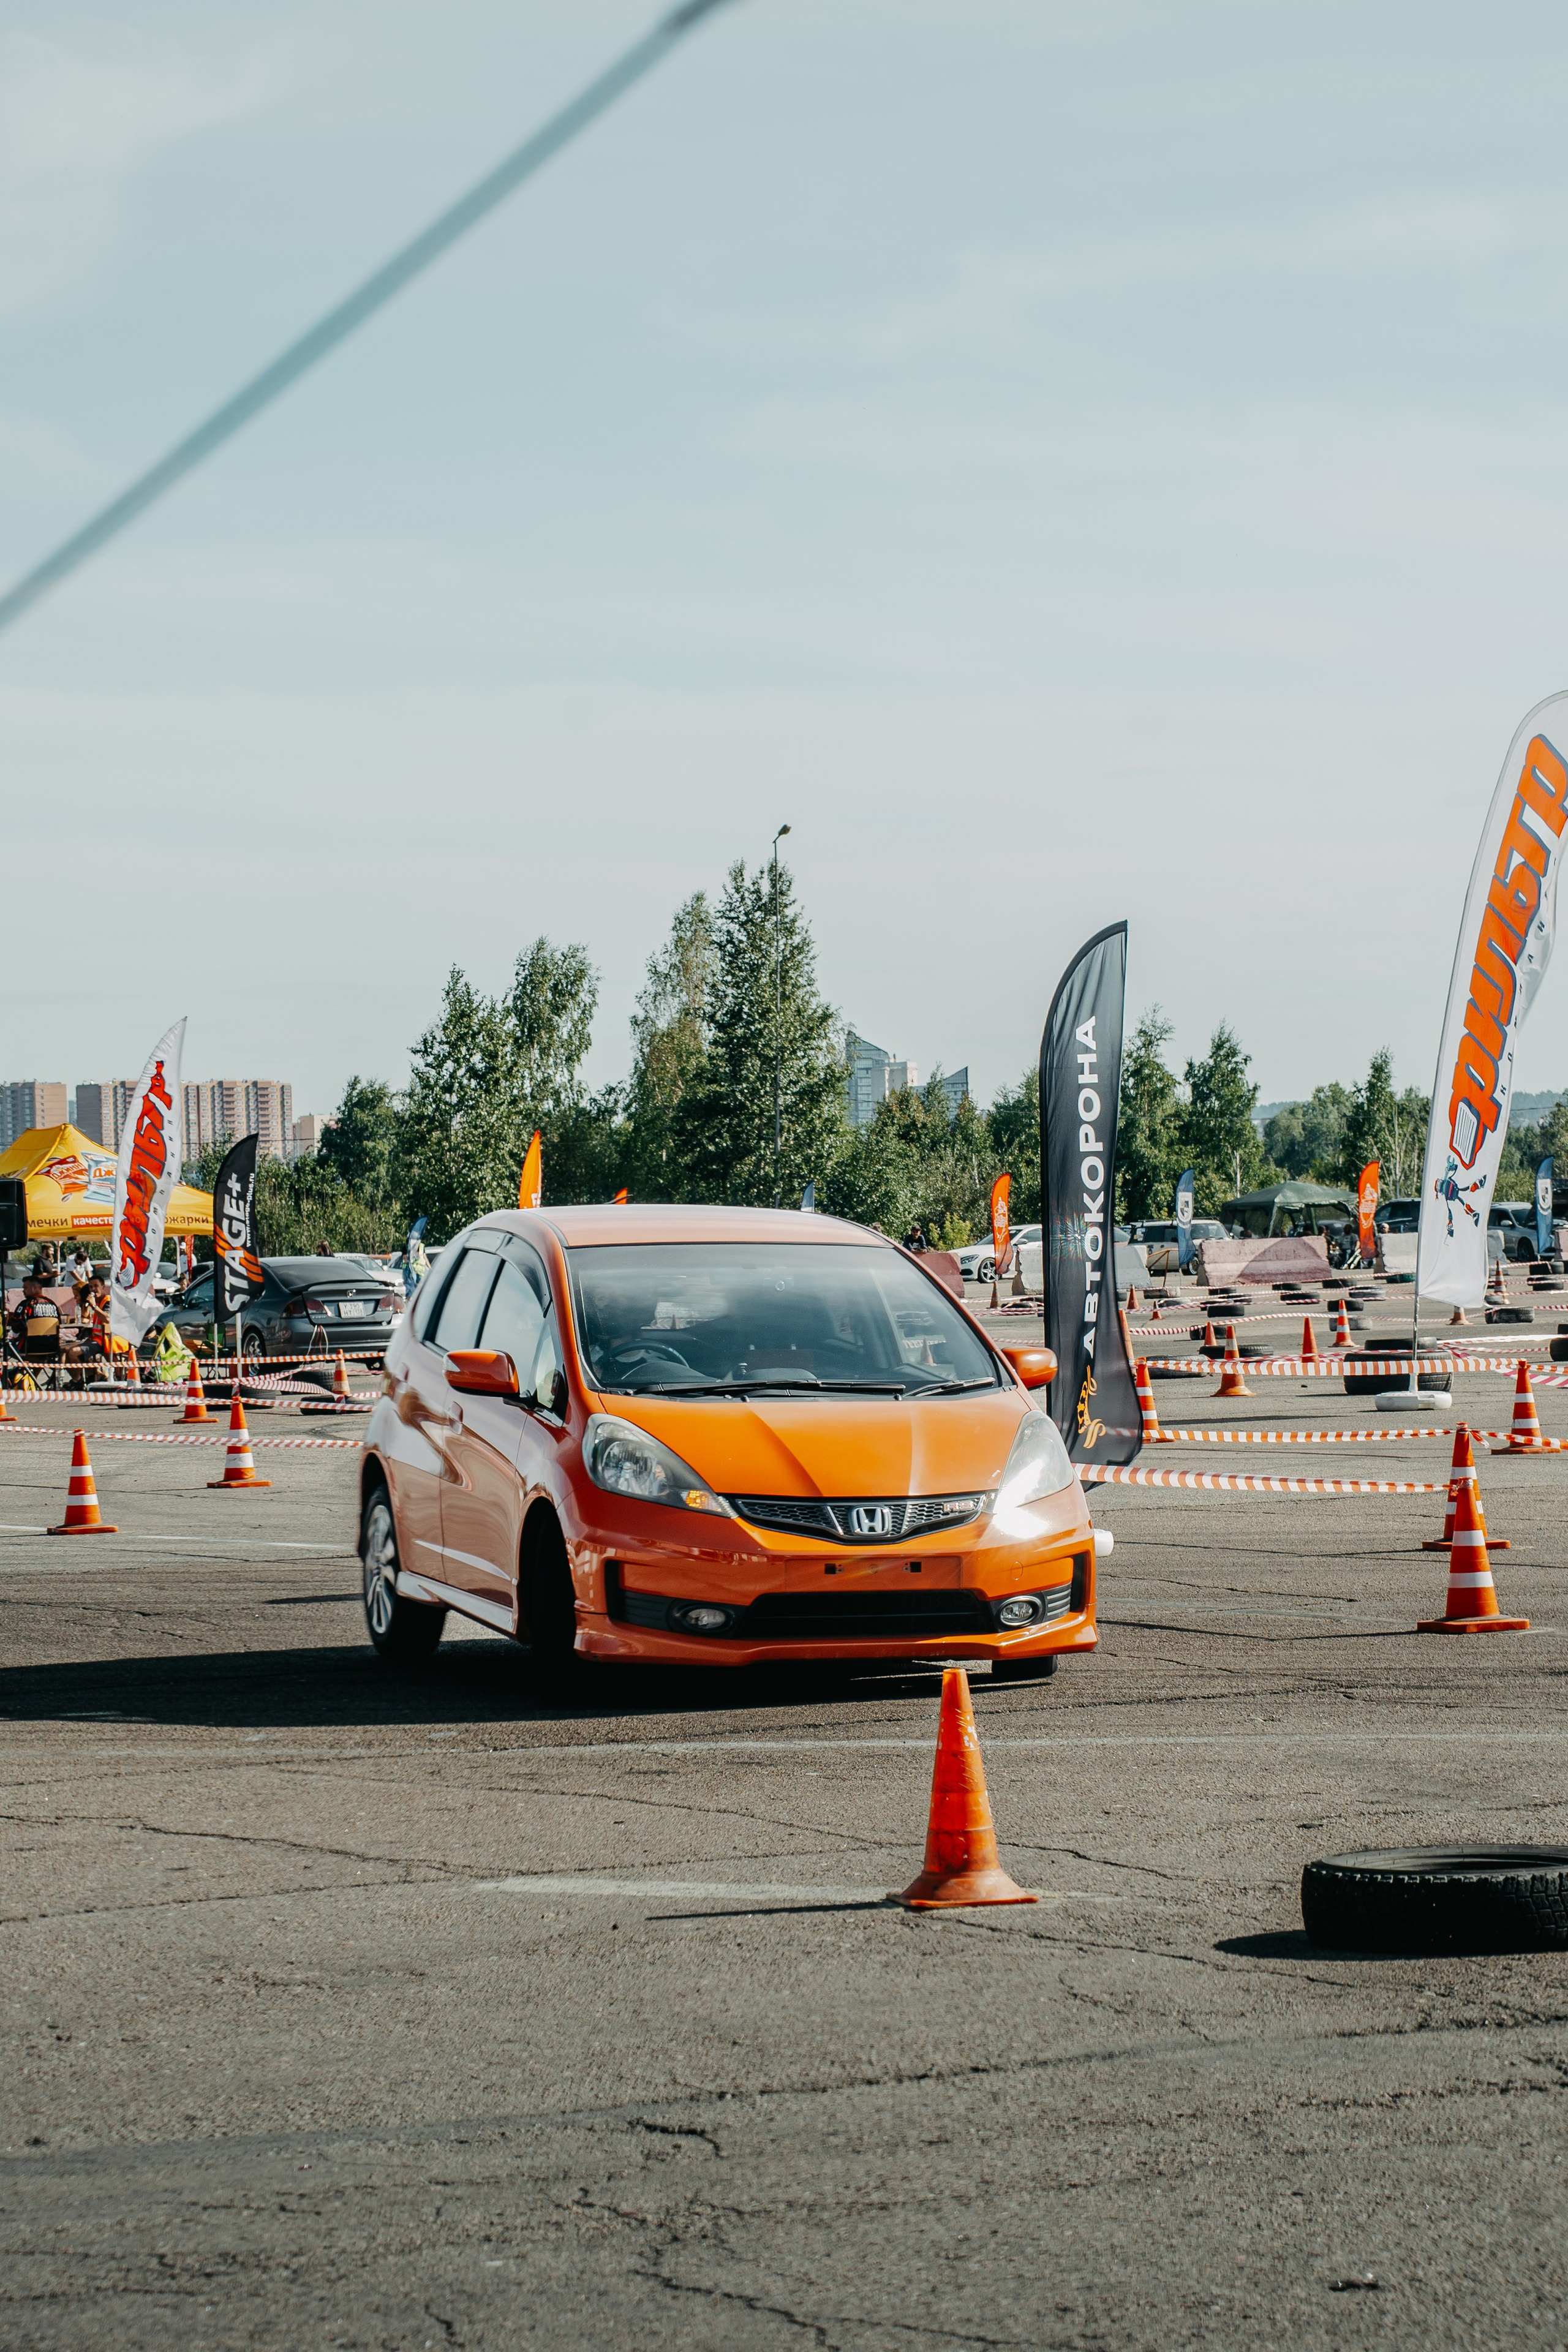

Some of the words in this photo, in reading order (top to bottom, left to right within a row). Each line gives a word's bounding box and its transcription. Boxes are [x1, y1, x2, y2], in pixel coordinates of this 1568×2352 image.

[27, 1216, 69, 1227] мечки
[1076, 1016, 1104, 1359] АВТОКОРОНА
[222, 1172, 250, 1311] STAGE+
[943, 1500, 974, 1512] RS
